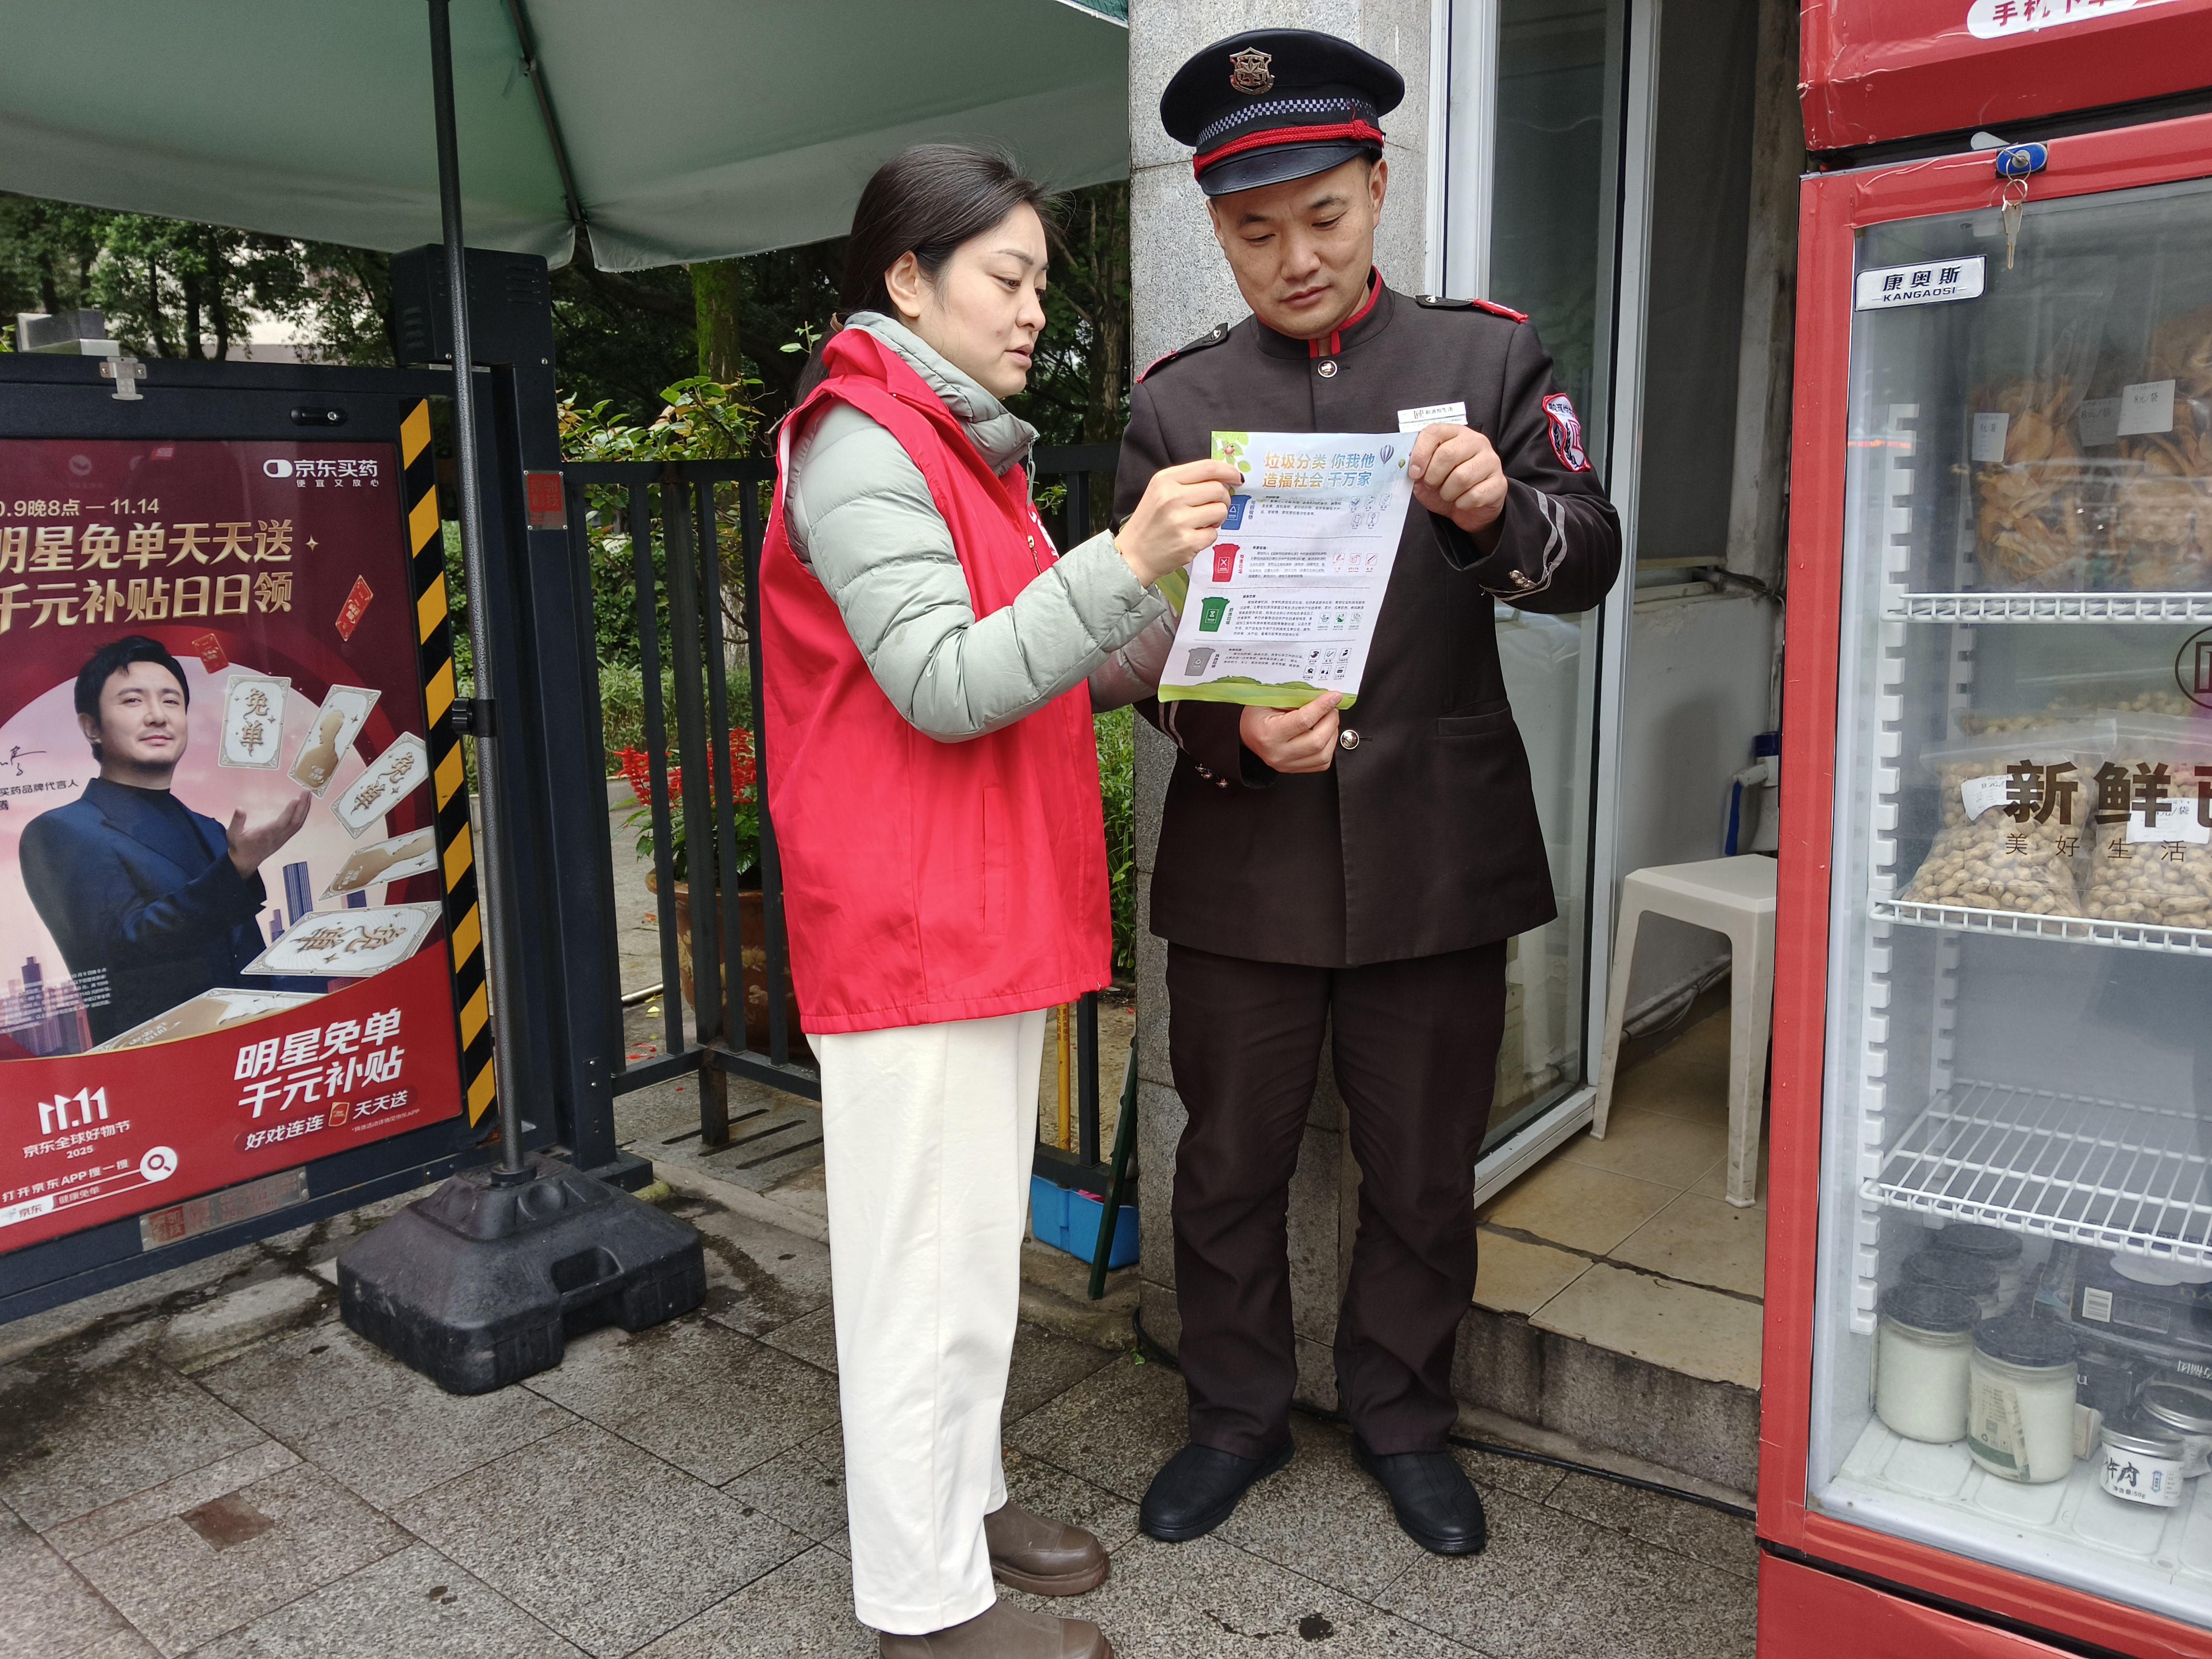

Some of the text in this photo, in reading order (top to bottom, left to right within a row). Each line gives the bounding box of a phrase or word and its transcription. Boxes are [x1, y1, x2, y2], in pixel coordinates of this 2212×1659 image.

[1882, 264, 1962, 291] 康奥斯
[1883, 286, 1956, 301] KANGAOSI
[294, 459, 377, 477] 京东买药
[1264, 451, 1376, 469] 垃圾分类 你我他
[296, 479, 379, 488] 便宜又放心
[1262, 471, 1372, 488] 造福社会 千万家
[0, 572, 293, 635] 千元补贴日日领
[240, 687, 269, 757] 免单
[0, 779, 78, 796] 买药品牌代言人
[2003, 759, 2212, 828] 新鲜
[2005, 833, 2187, 862] 美好生活
[234, 1007, 401, 1081] 明星免单
[238, 1045, 405, 1118] 千元补贴
[38, 1086, 108, 1135] 11.11
[244, 1090, 409, 1151] 好戏连连 天天送
[23, 1120, 131, 1159] 京东全球好物节
[66, 1145, 94, 1159] 2025
[1, 1158, 130, 1203] 打开京东APP搜一搜
[18, 1204, 43, 1218] 京东
